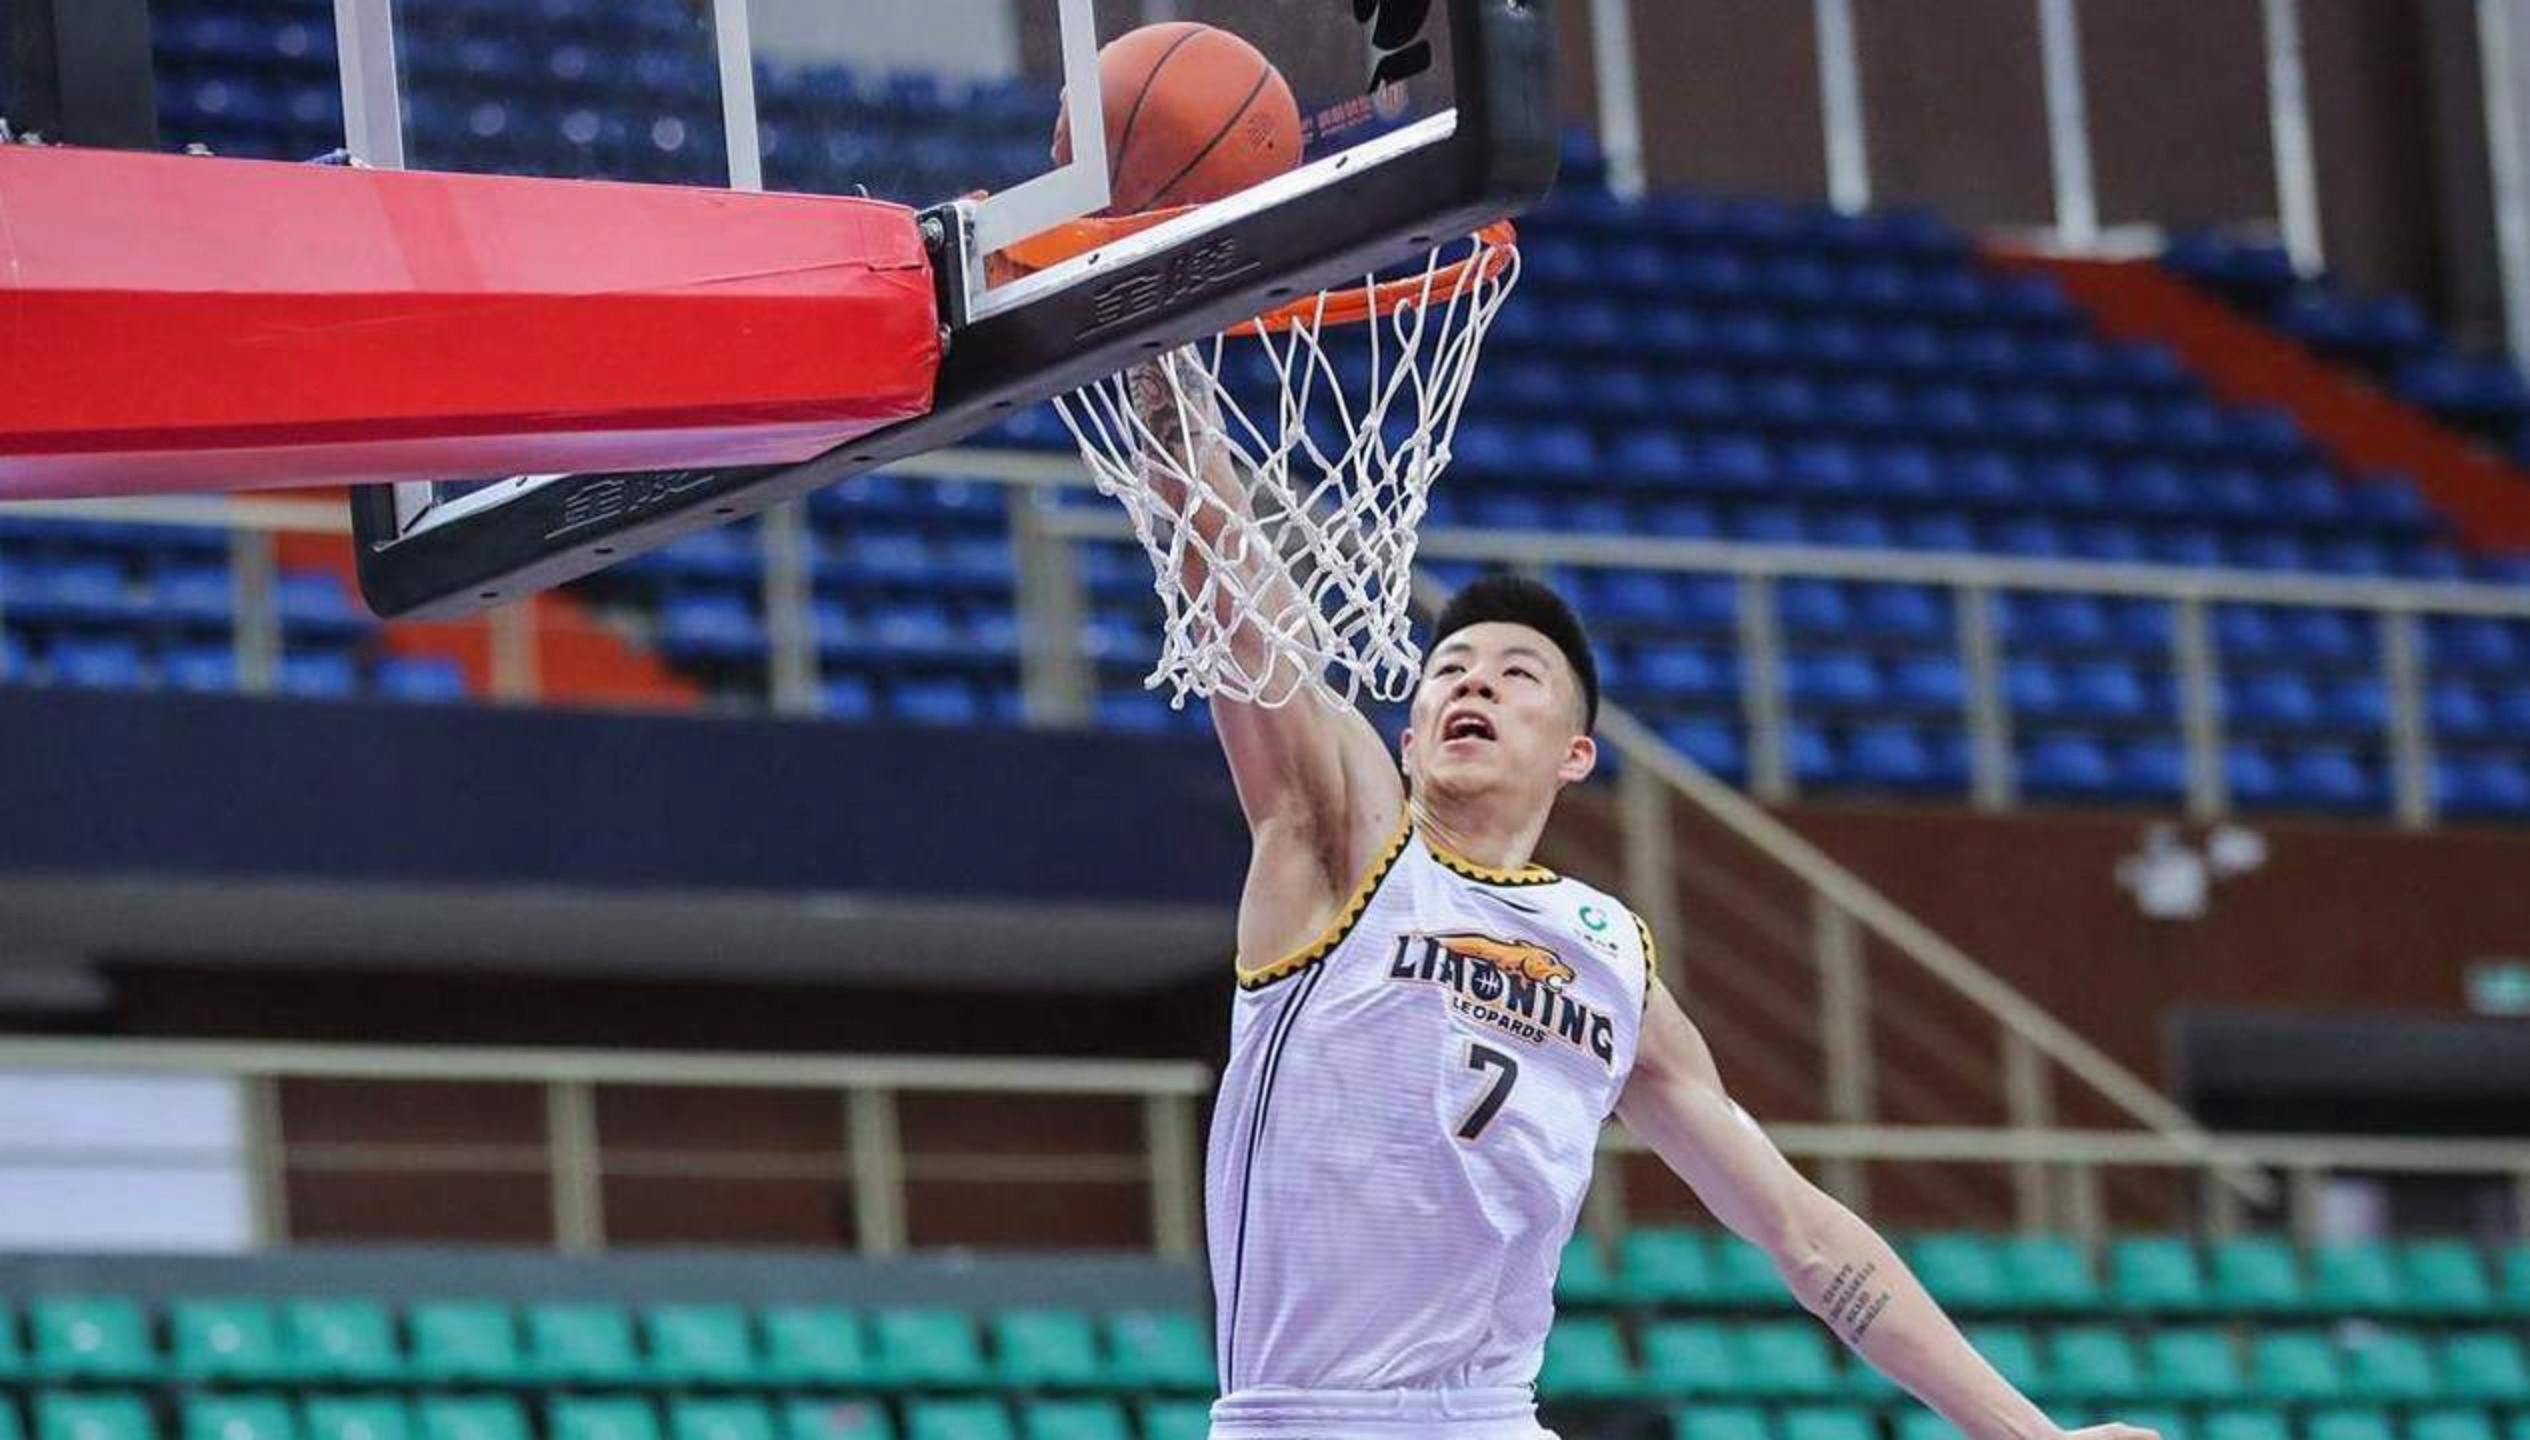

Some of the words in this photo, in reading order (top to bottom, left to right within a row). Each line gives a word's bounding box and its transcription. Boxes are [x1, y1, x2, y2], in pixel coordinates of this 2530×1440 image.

[1389, 934, 1614, 1066] LIAONING
[1452, 996, 1548, 1044] LEOPARDS
[1456, 1043, 1519, 1140] 7
